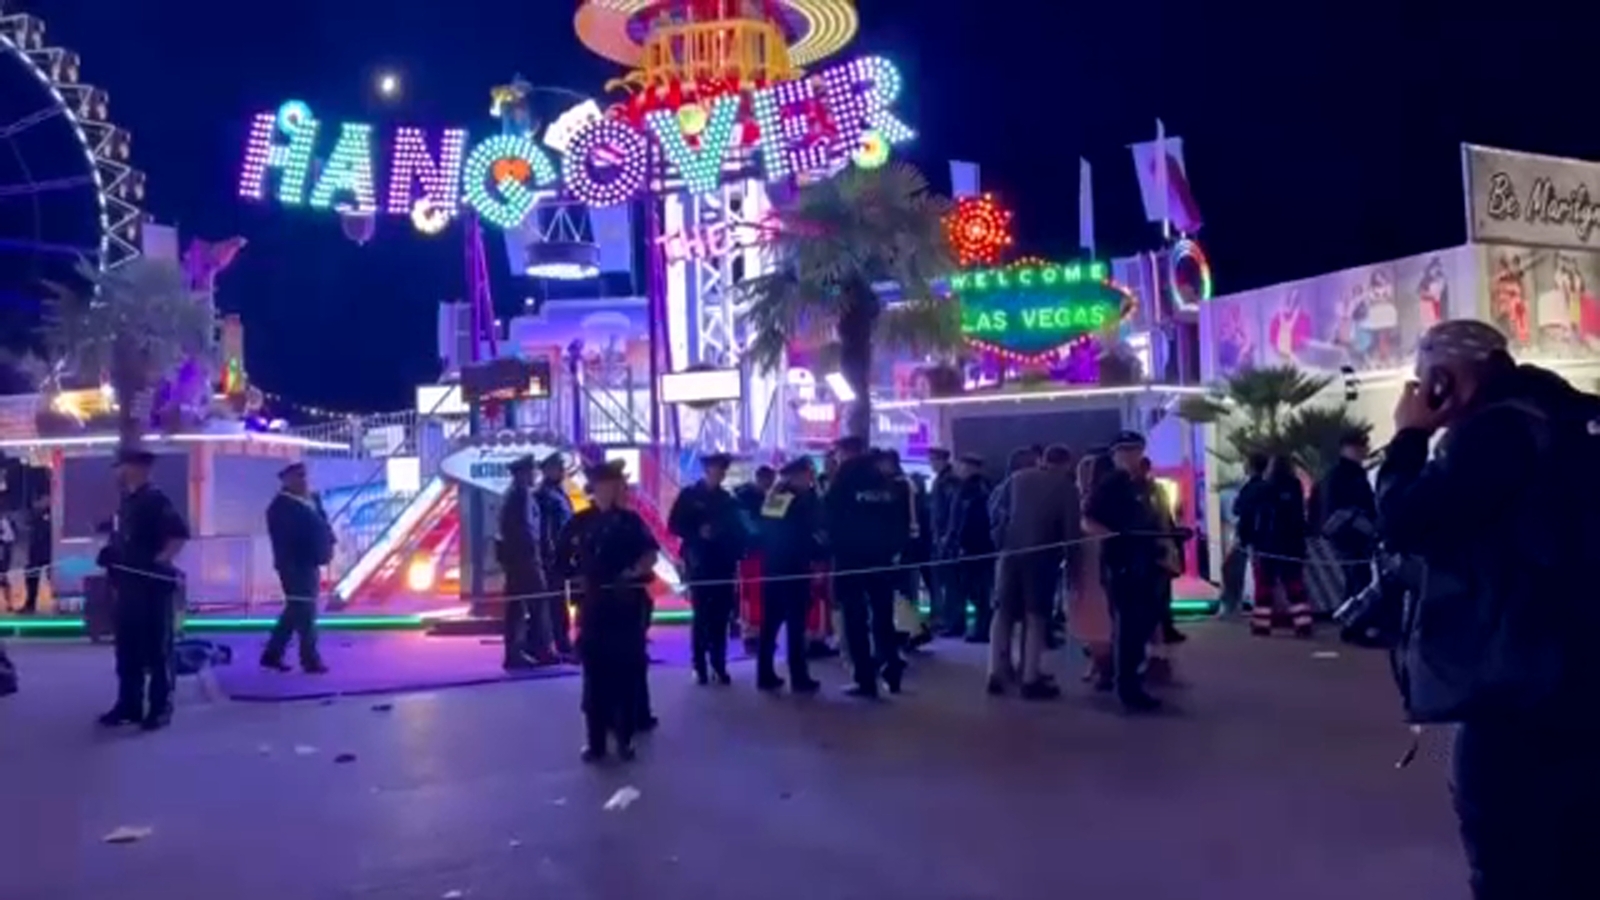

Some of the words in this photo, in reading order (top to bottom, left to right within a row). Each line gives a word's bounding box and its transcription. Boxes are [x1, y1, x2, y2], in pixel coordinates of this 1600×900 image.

[238, 56, 916, 227] HANGOVER
[1488, 172, 1520, 220] Be
[950, 262, 1108, 289] WELCOME
[961, 309, 1008, 333] LAS
[1022, 303, 1106, 330] VEGAS
